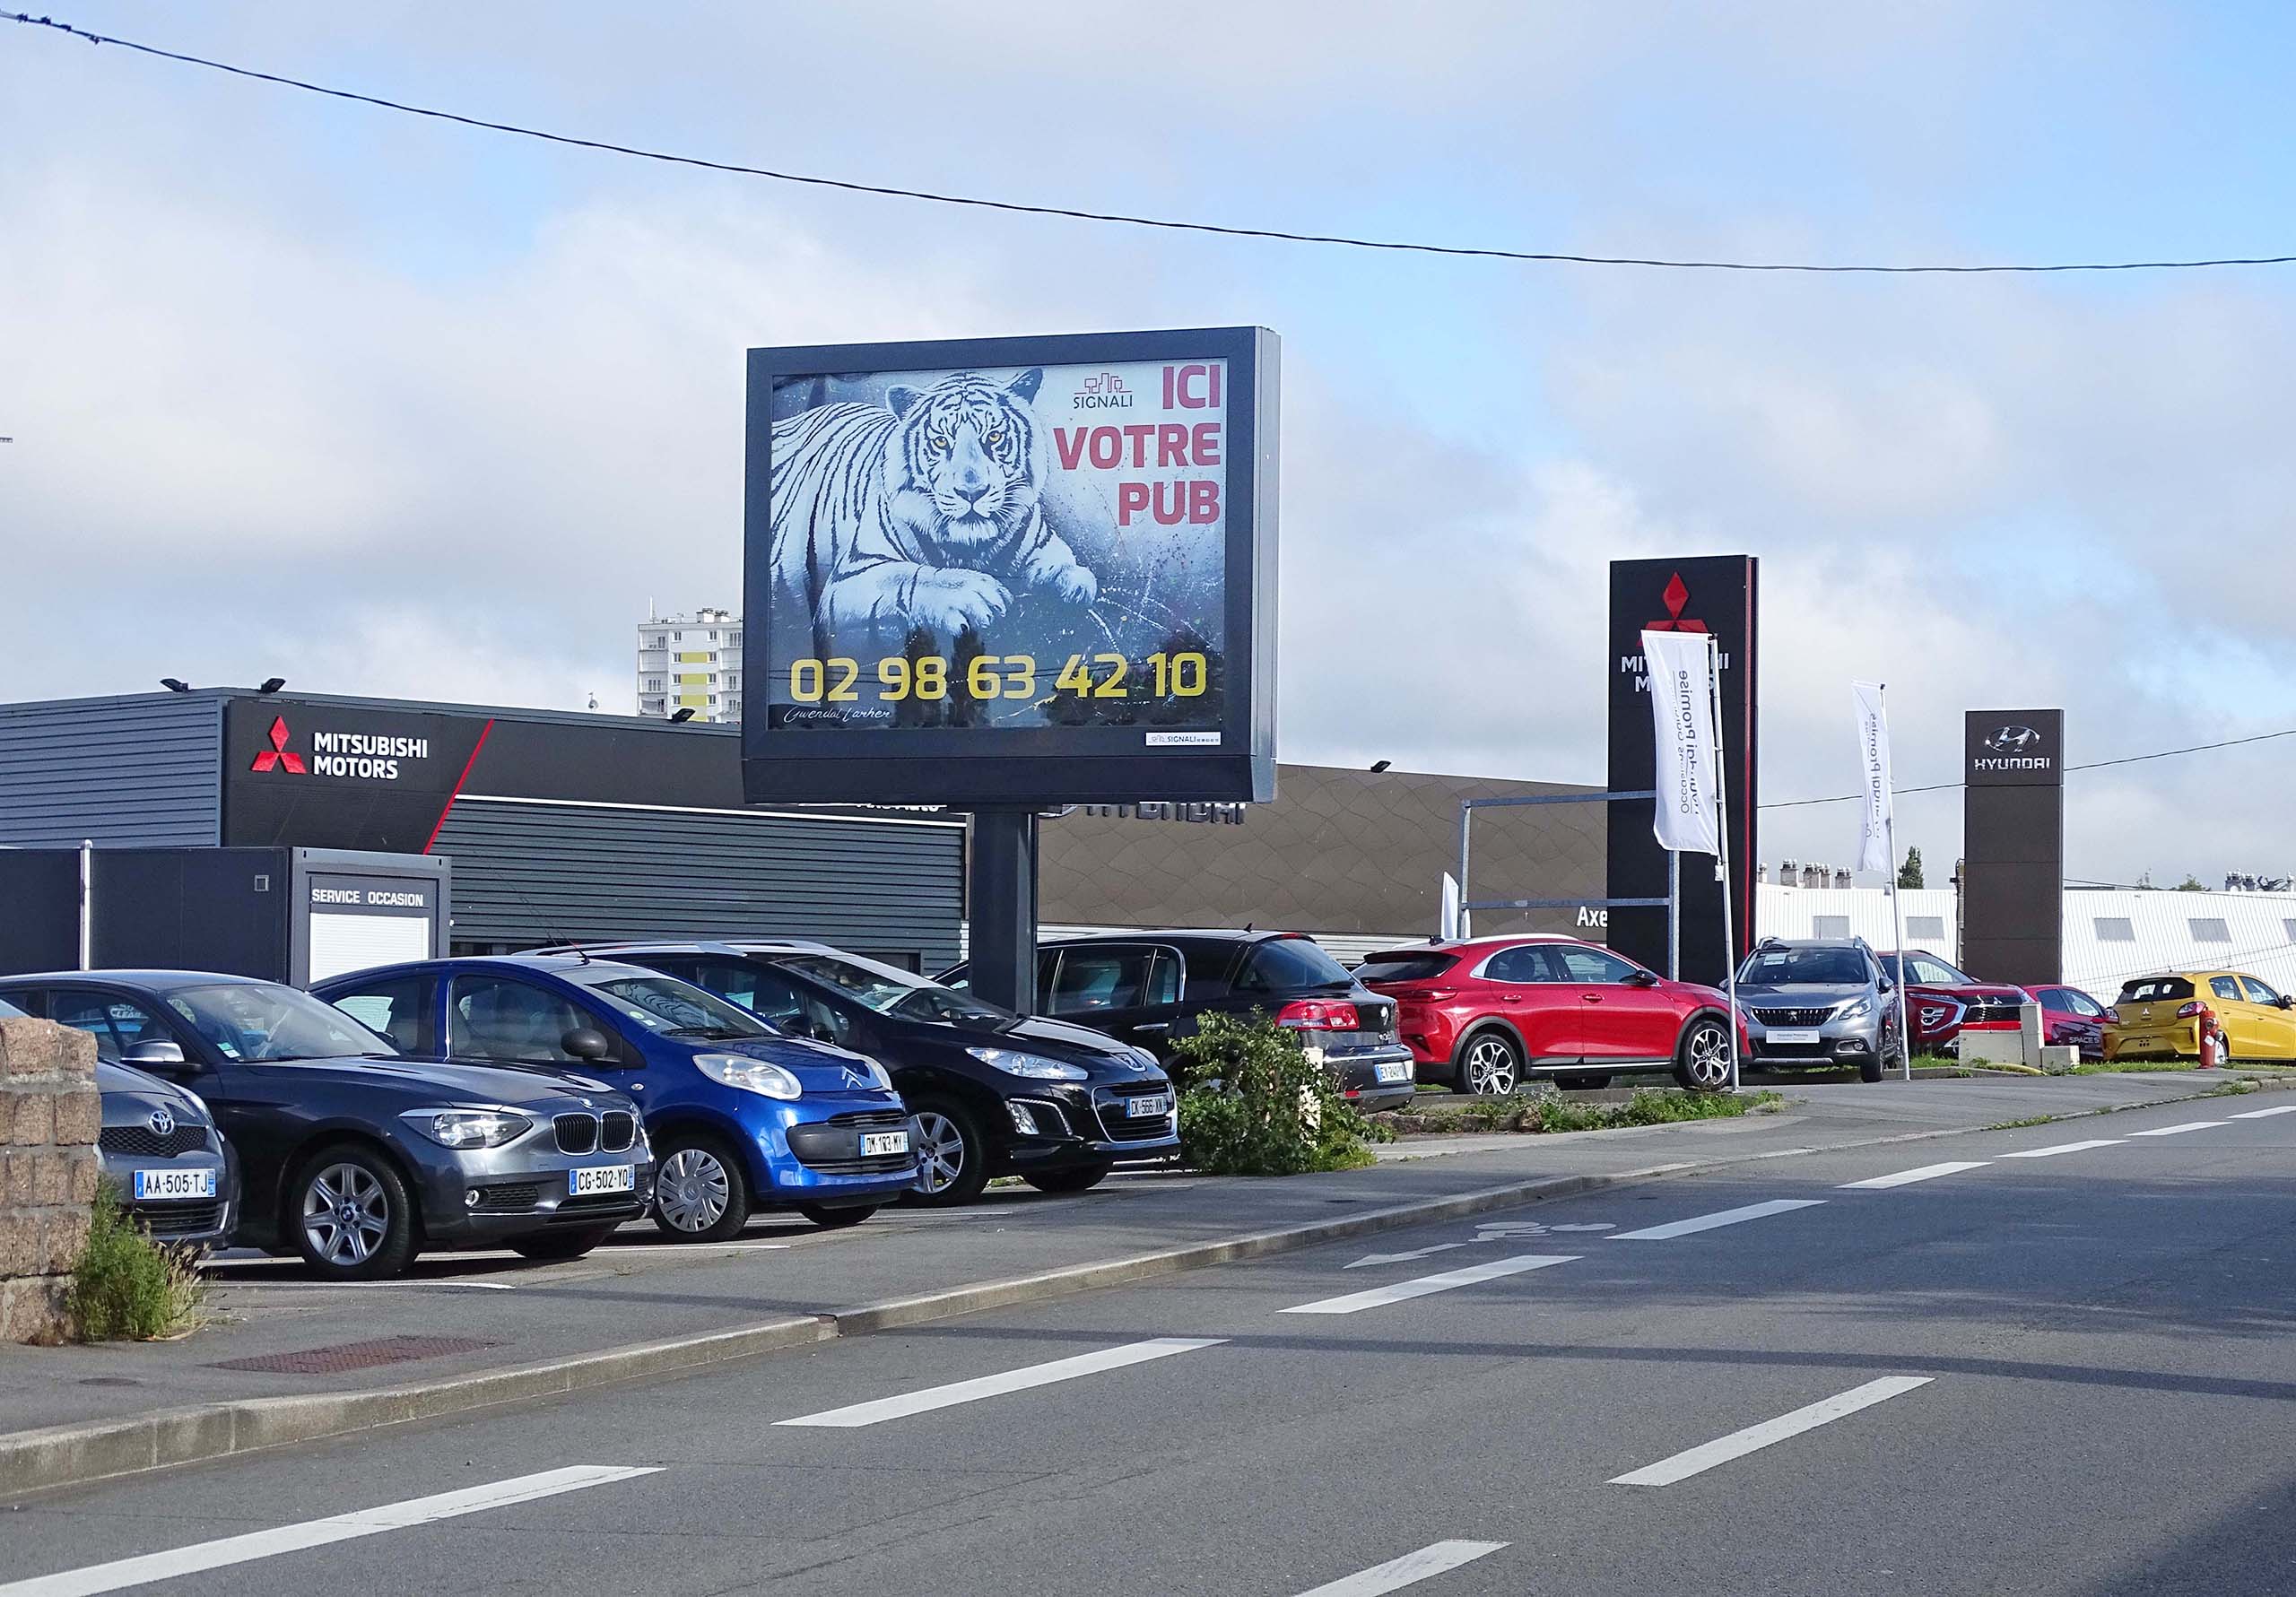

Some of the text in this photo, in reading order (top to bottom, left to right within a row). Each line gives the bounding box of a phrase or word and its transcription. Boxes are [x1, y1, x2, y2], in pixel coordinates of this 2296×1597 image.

[1162, 364, 1221, 409] ICI
[1074, 395, 1133, 409] SIGNALI
[1053, 422, 1221, 470] VOTRE
[1118, 481, 1220, 525] PUB
[790, 652, 1207, 702] 02 98 63 42 10
[314, 732, 428, 758] MITSUBISHI
[314, 755, 398, 779] MOTORS
[1974, 757, 2050, 770] HYUNDAI
[311, 889, 424, 907] SERVICE OCCASION
[145, 1173, 207, 1193] AA-505-TJ
